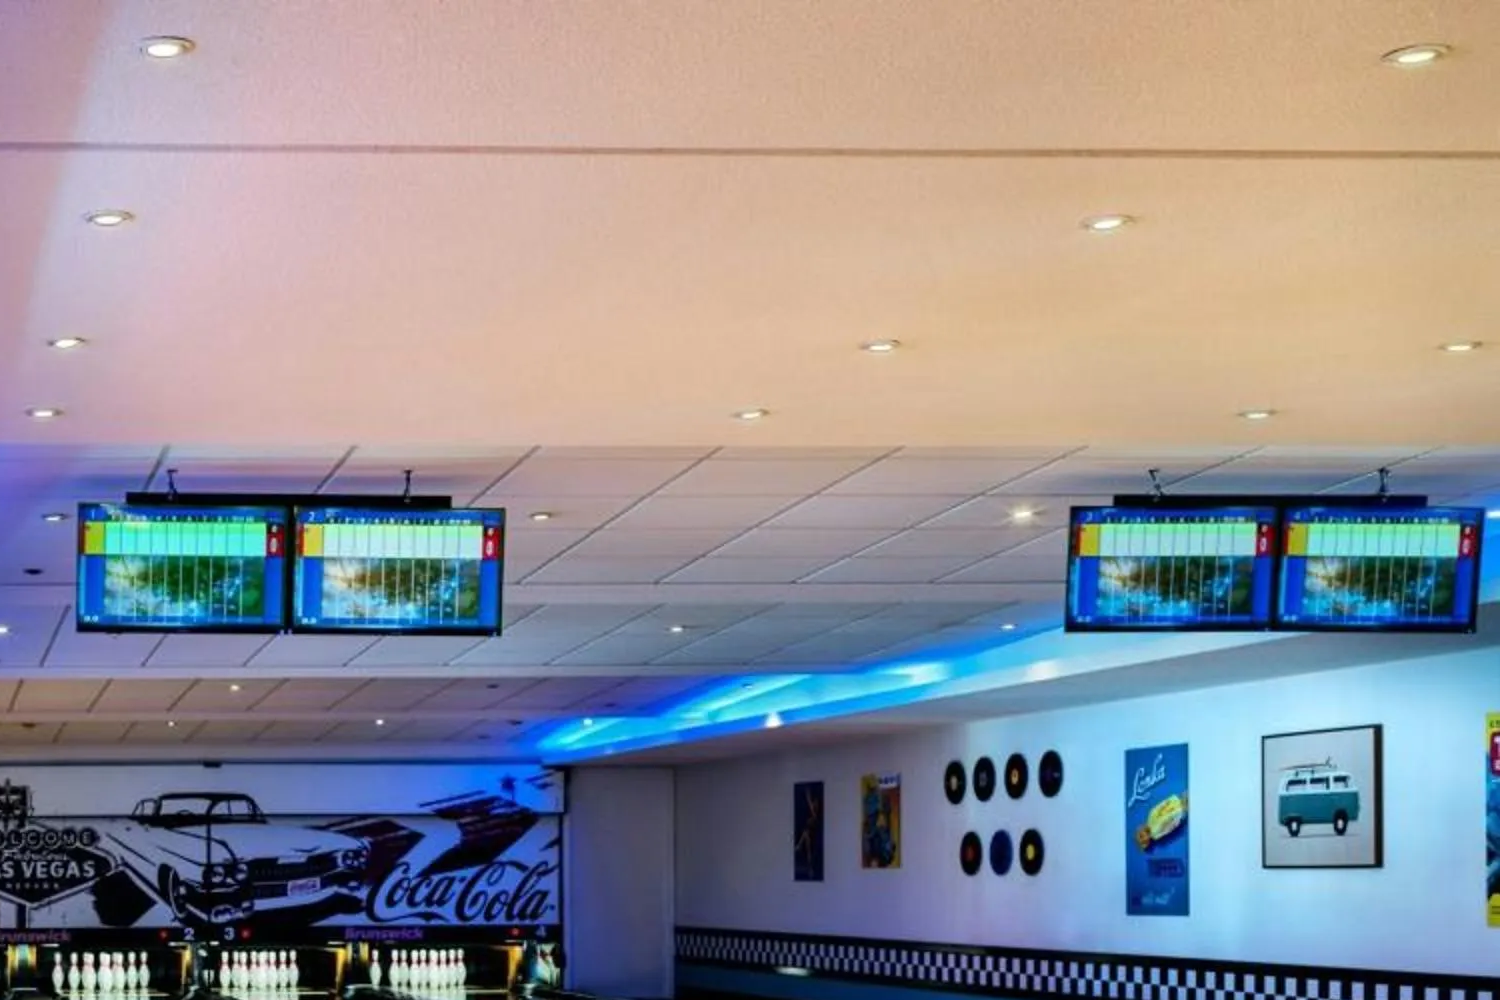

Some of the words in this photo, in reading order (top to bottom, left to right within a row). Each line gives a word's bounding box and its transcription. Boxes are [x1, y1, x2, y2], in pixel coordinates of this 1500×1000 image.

[21, 861, 96, 879] VEGAS
[365, 860, 559, 923] Coca-Cola
[184, 928, 195, 941] 2
[224, 928, 235, 941] 3
[344, 928, 424, 941] Brunswick
